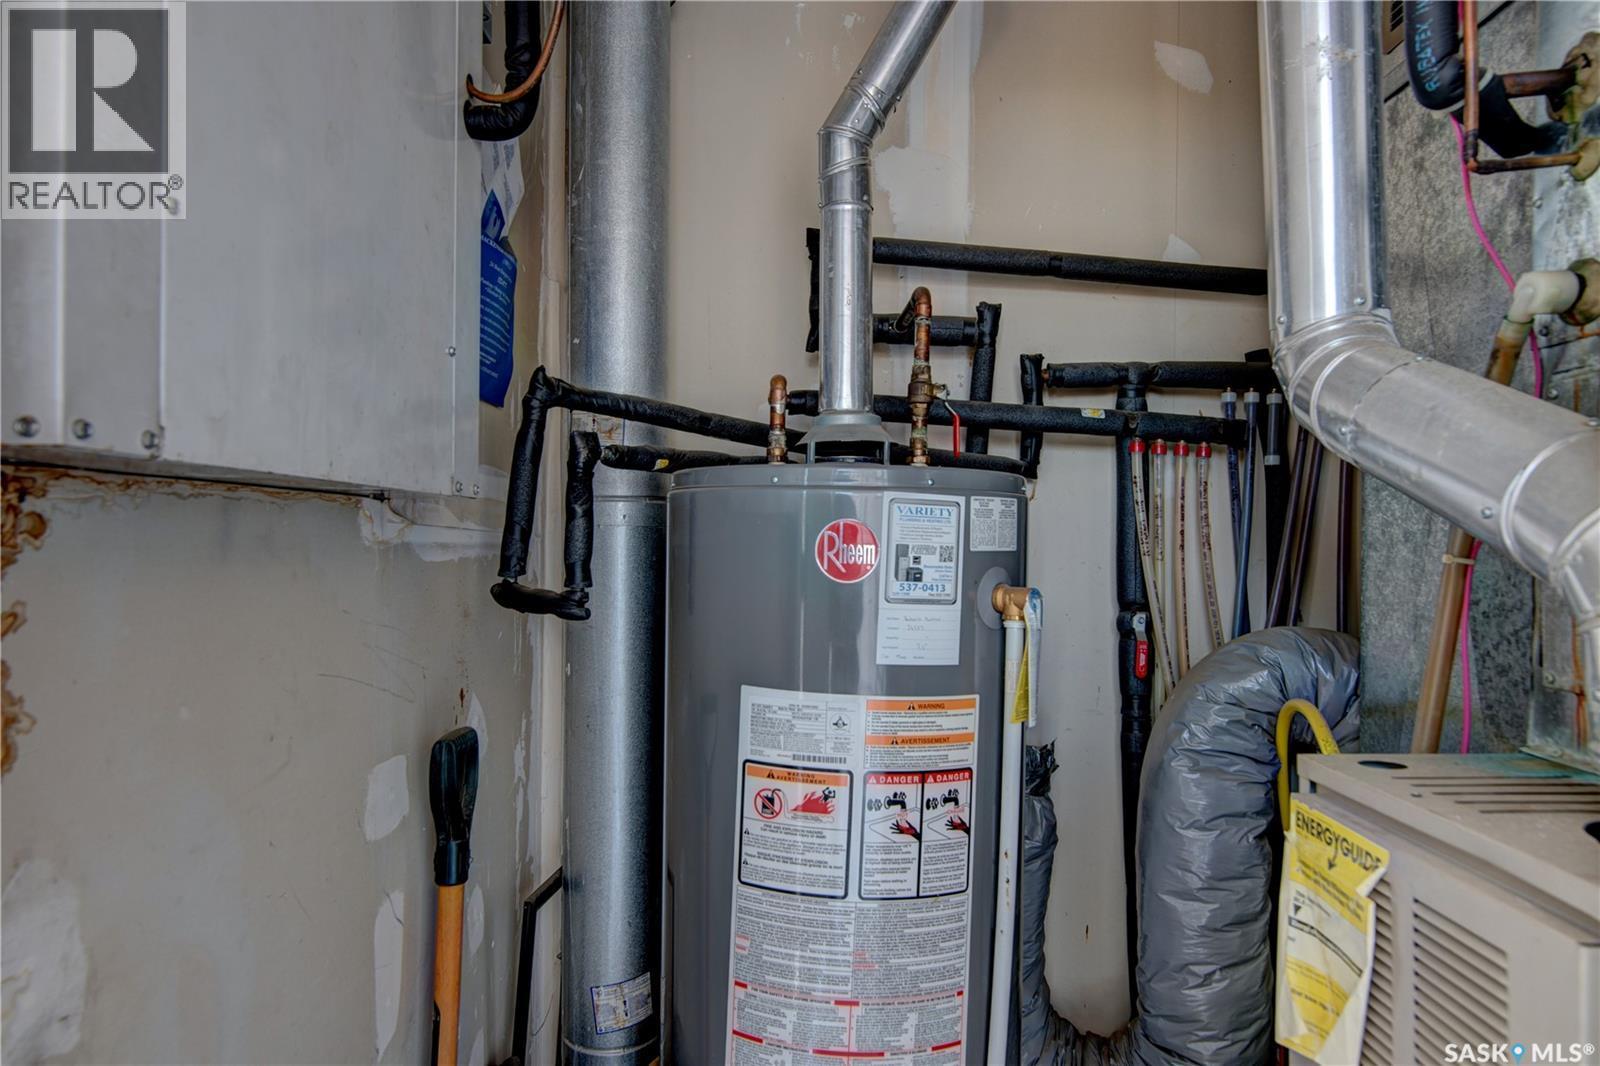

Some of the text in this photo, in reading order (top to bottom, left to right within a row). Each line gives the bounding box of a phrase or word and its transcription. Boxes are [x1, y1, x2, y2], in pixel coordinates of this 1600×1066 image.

[896, 505, 954, 517] VARIETY
[823, 519, 876, 574] Rheem
[899, 583, 946, 593] 537-0413
[900, 737, 950, 745] AVERTISSEMENT
[776, 775, 827, 785] AVERTISSEMENT
[786, 771, 816, 779] WARNING
[879, 775, 920, 784] DANGER
[936, 772, 970, 782] DANGER
